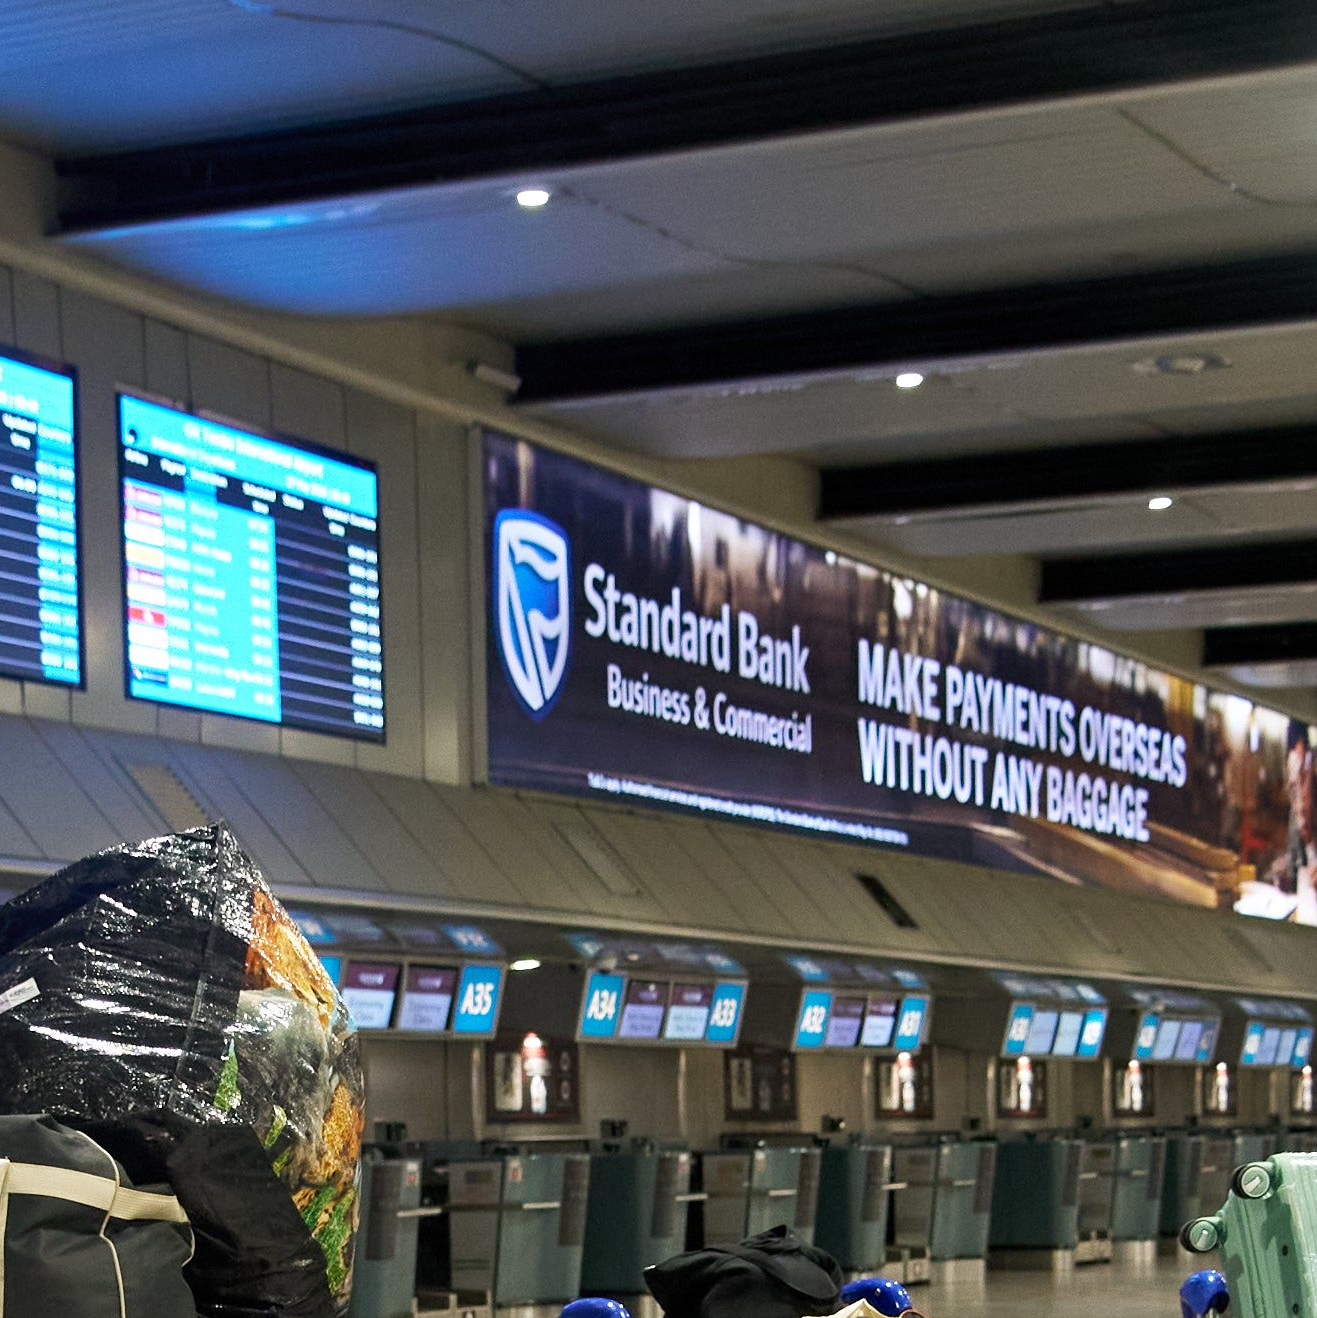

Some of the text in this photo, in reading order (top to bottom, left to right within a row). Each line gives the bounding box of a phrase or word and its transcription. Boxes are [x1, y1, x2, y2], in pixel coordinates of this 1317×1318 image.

[584, 562, 810, 694] Standard Bank
[607, 663, 812, 753] Business & Commercial
[858, 637, 1187, 788] MAKE PAYMENTS OVERSEAS
[858, 717, 989, 806] WITHOUT
[990, 752, 1043, 819] ANY
[1046, 765, 1150, 842] BAGGAGE
[460, 982, 494, 1015] A35
[587, 989, 617, 1020] A34
[710, 998, 737, 1027] A33
